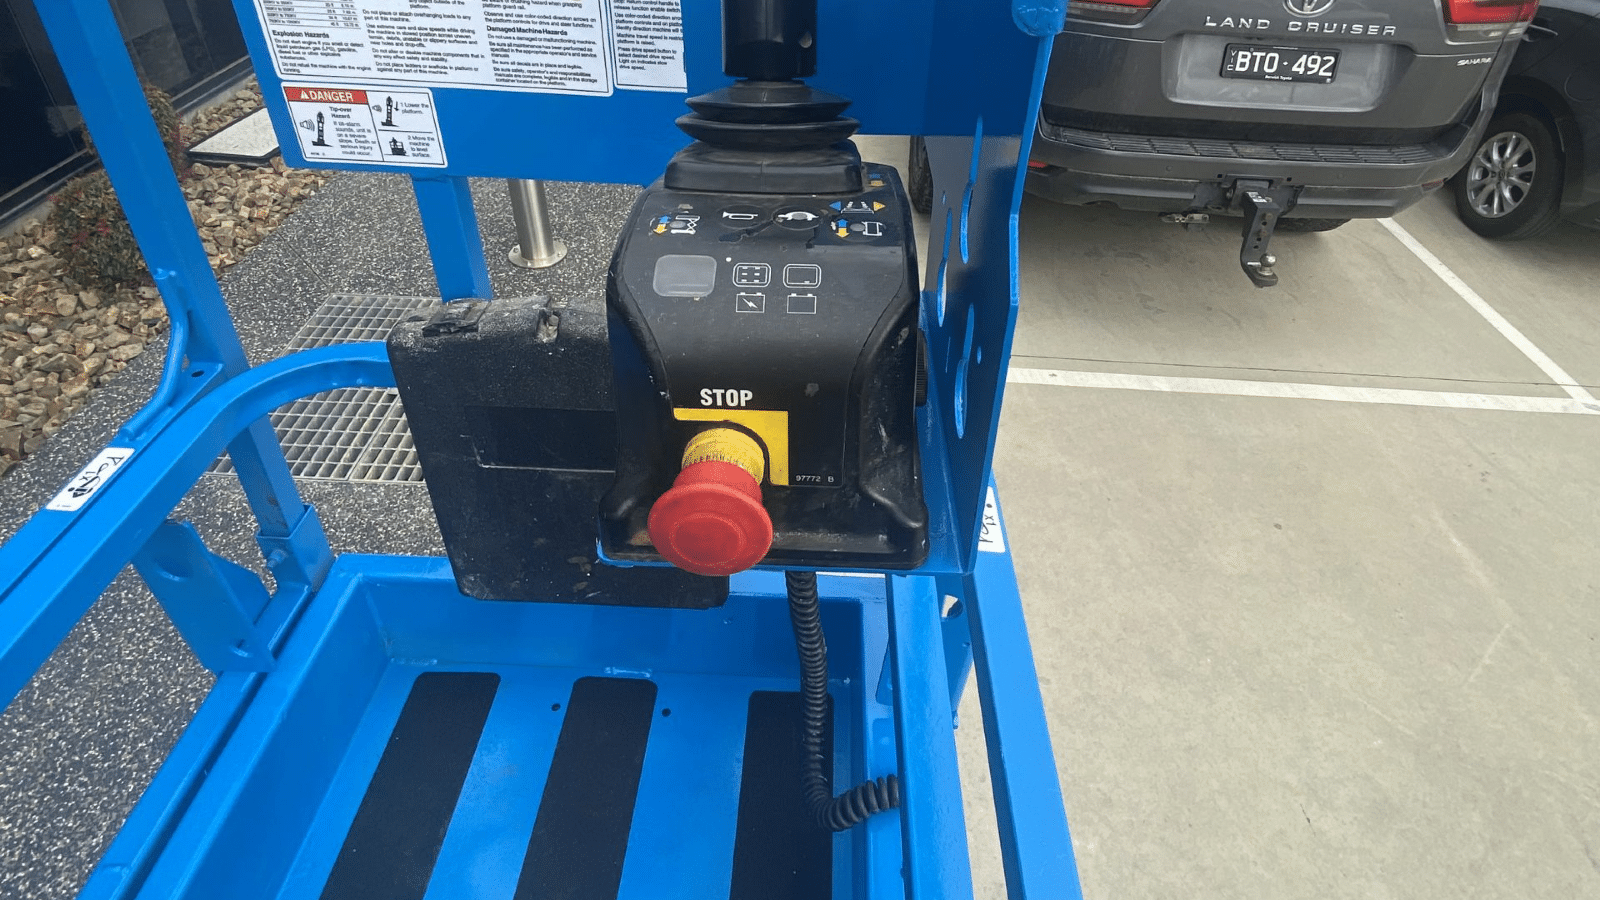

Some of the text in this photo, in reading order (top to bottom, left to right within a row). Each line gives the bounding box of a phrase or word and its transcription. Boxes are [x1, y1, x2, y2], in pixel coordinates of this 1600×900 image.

[1205, 16, 1396, 36] LAND CRUISER
[1292, 54, 1335, 77] 492
[309, 91, 354, 102] DANGER
[700, 388, 753, 406] STOP
